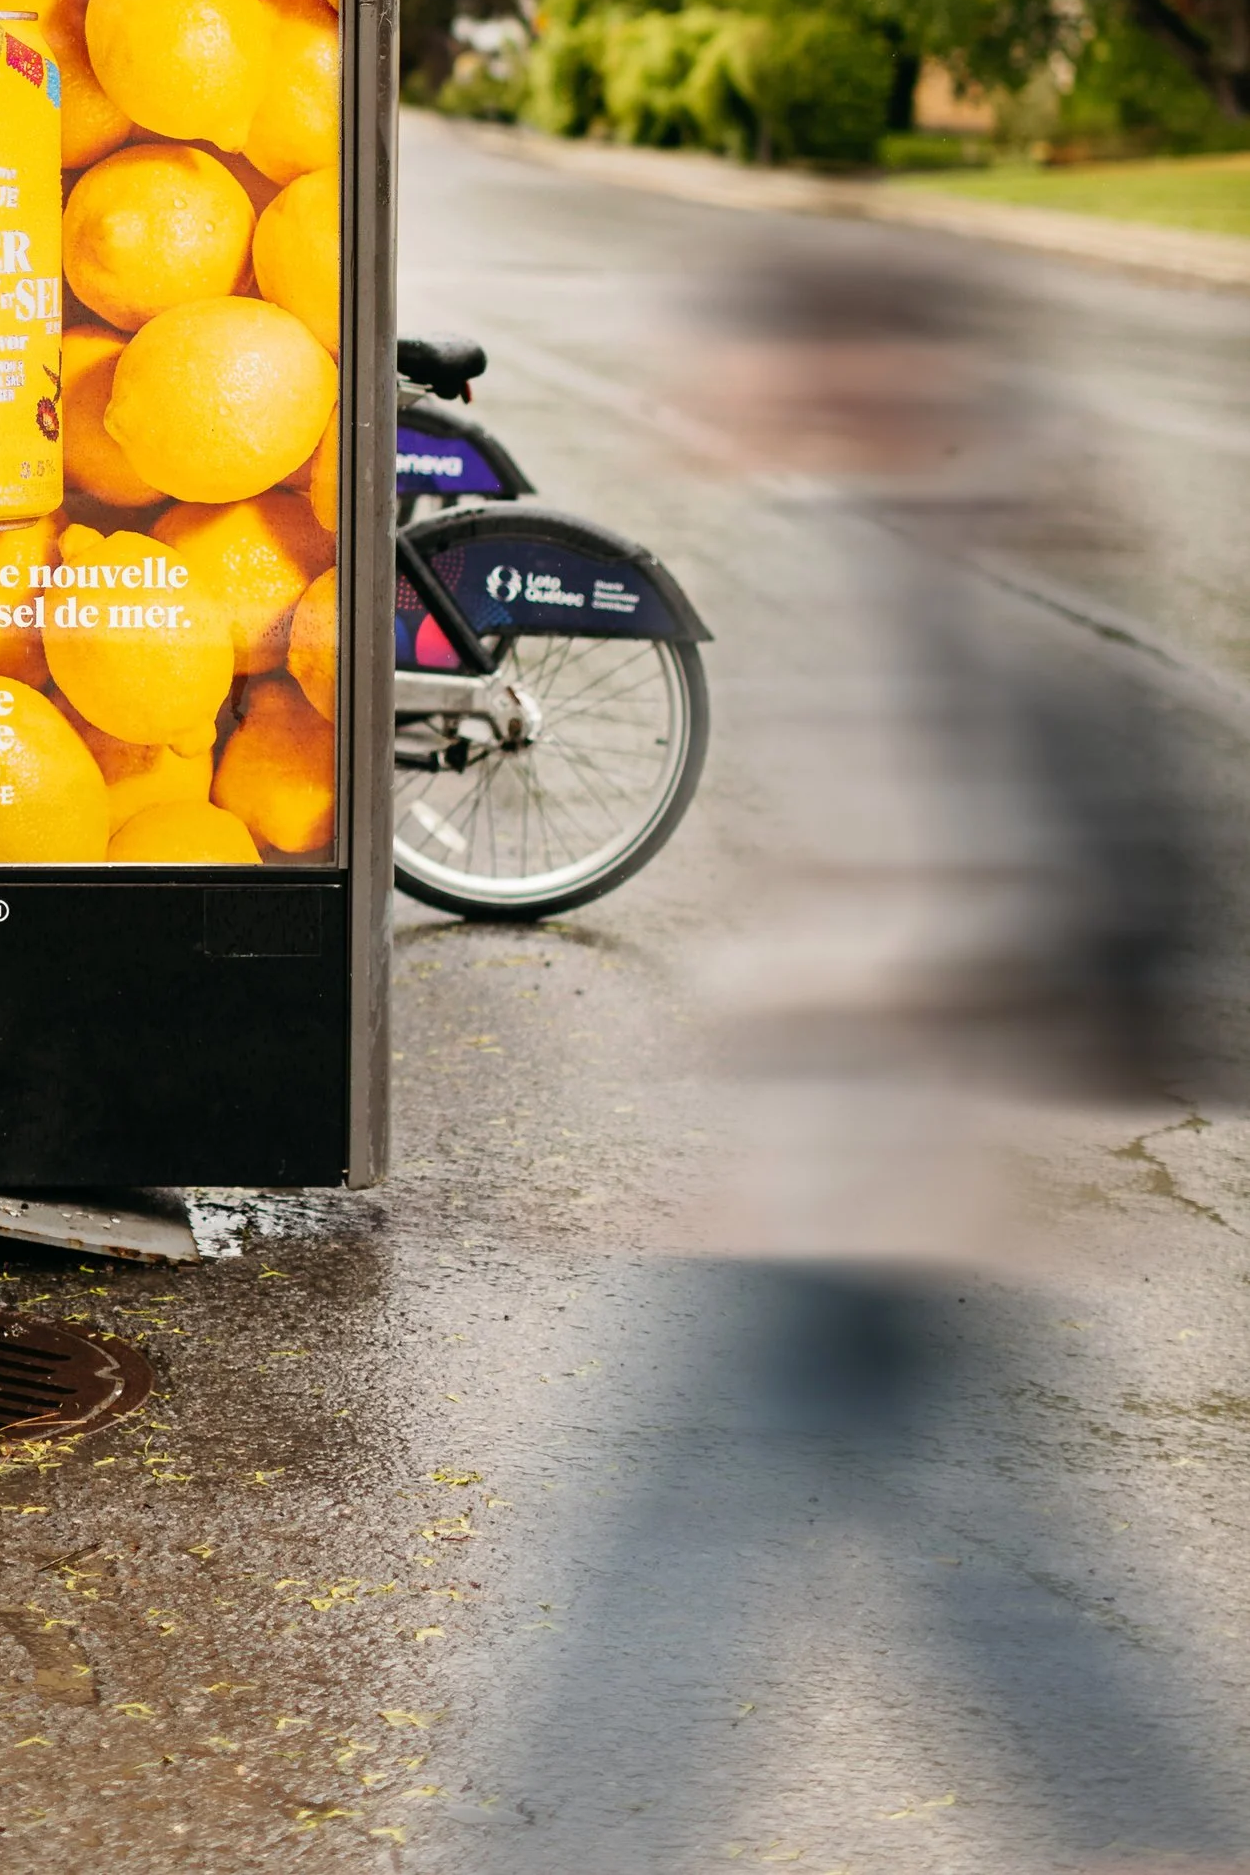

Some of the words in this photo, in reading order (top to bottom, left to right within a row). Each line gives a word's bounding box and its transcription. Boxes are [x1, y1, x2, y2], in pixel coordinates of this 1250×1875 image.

[29, 557, 189, 589] nouvelle
[54, 596, 99, 629] de
[108, 606, 193, 629] mer.
